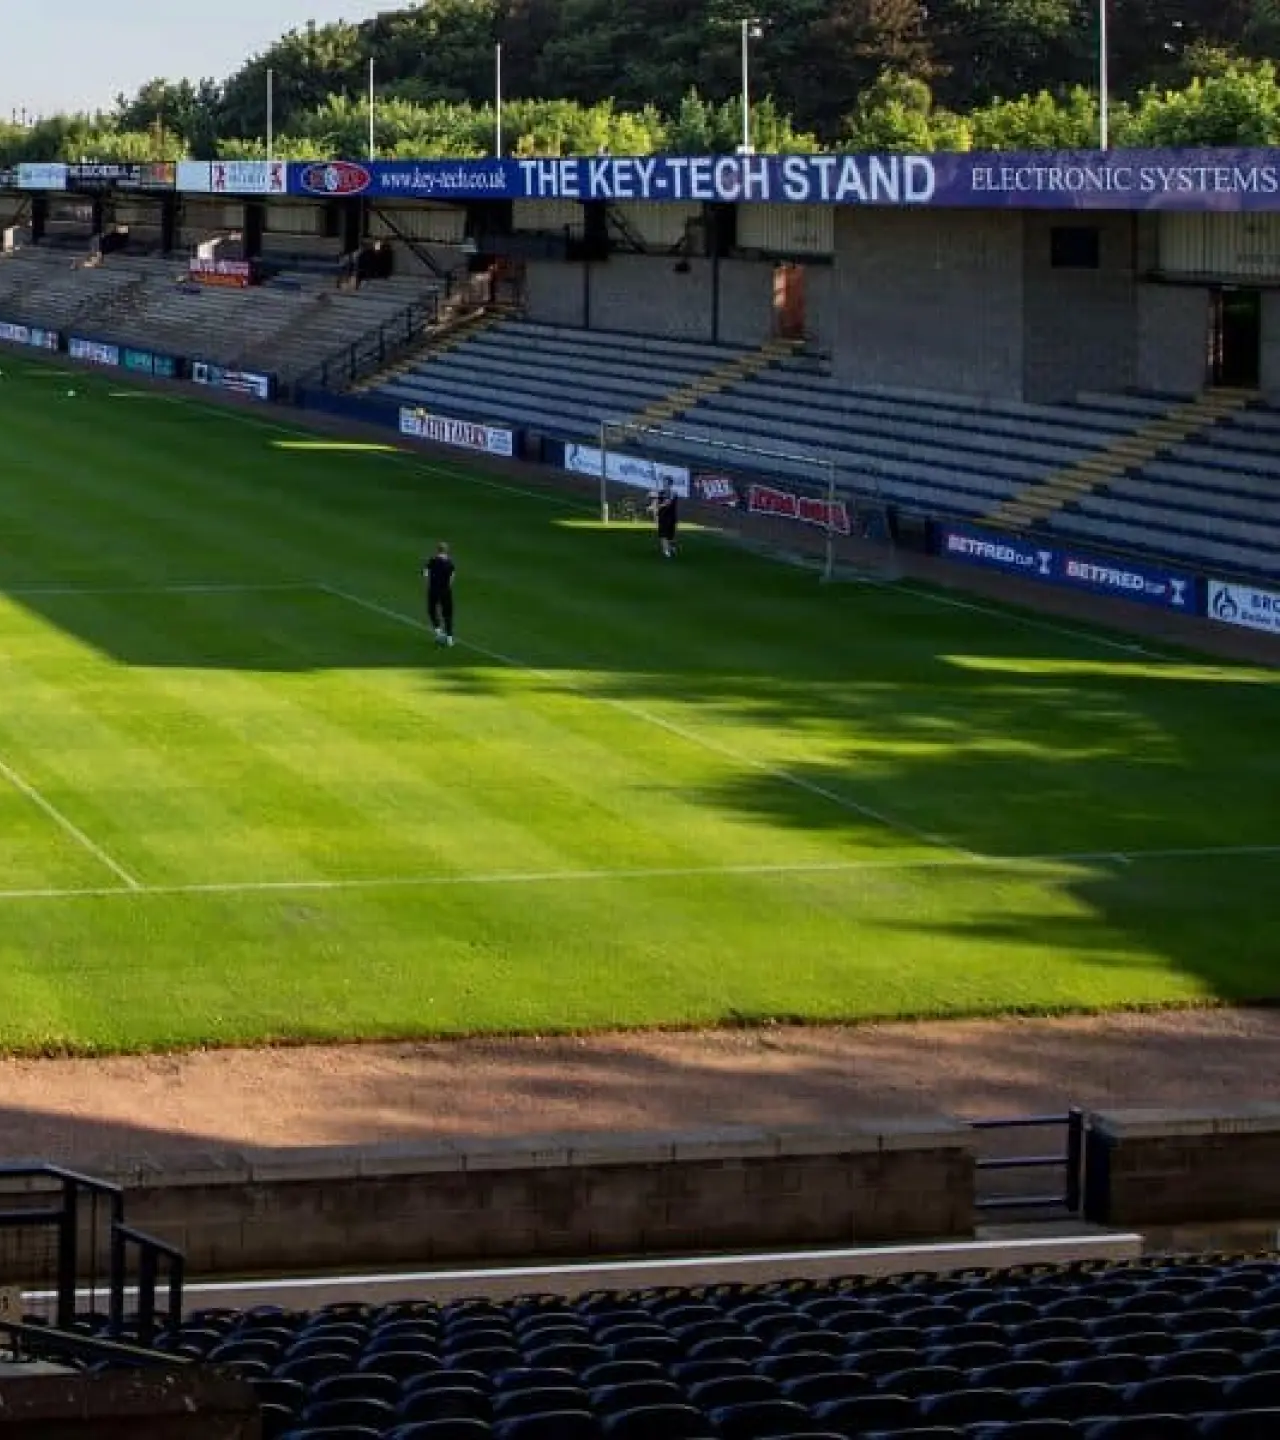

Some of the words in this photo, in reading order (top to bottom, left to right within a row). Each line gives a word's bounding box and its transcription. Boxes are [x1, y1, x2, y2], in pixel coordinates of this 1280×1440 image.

[518, 159, 580, 197] THE
[588, 157, 771, 200] KEY-TECH
[782, 155, 936, 202] STAND
[971, 166, 1133, 191] ELECTRONIC
[1139, 166, 1279, 193] SYSTEMS
[947, 534, 1015, 563] BETFRED
[1065, 560, 1144, 590] BETFRED
